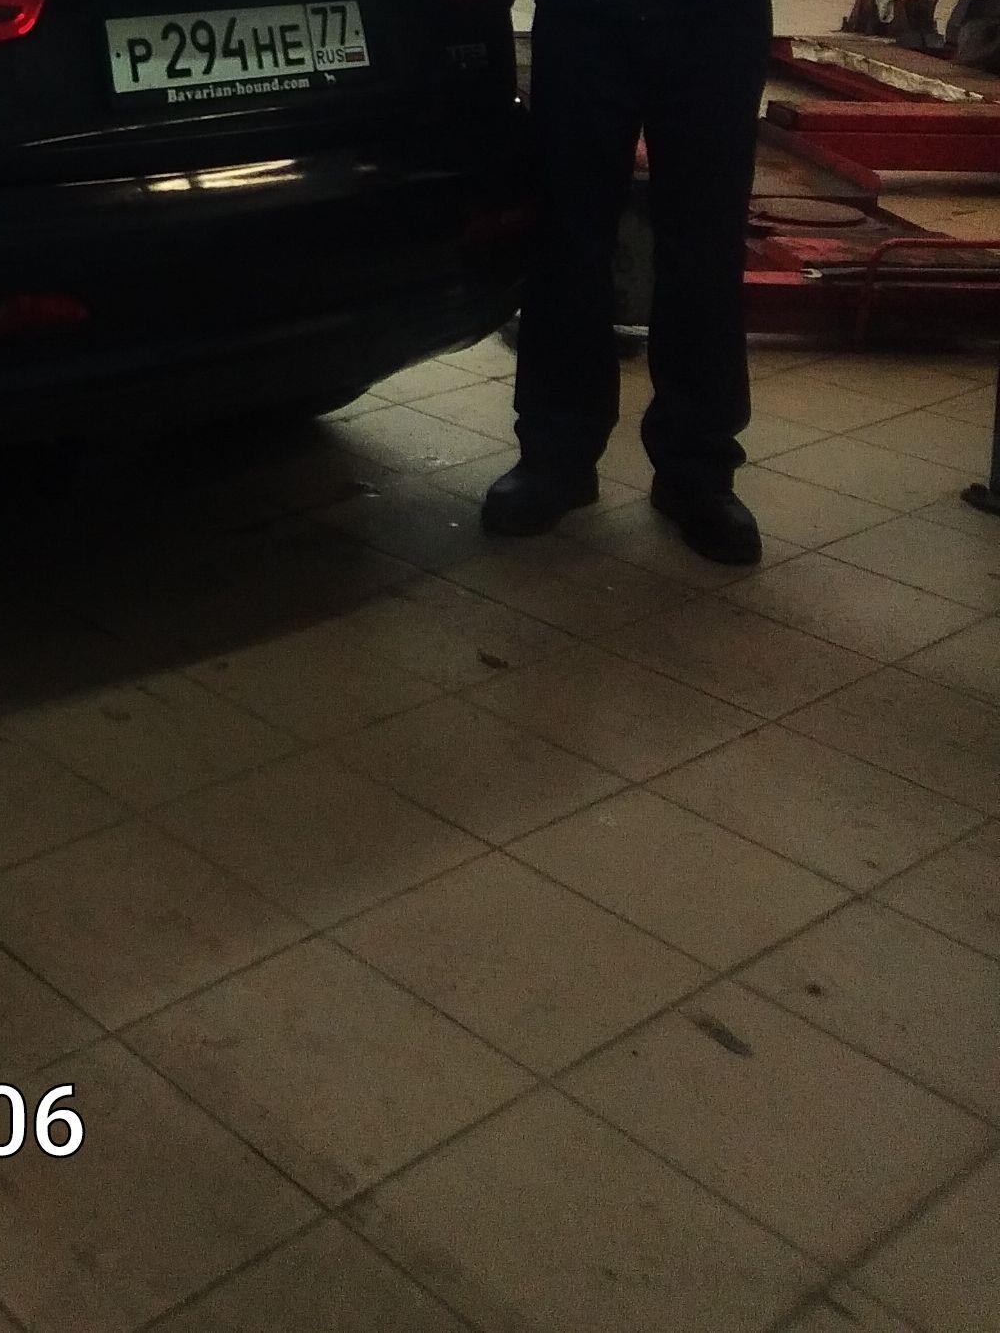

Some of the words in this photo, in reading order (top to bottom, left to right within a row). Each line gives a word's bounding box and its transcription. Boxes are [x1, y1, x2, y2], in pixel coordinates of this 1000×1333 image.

[310, 5, 348, 48] 77
[316, 48, 345, 65] RUS
[166, 77, 311, 104] Bavarian-hound.com
